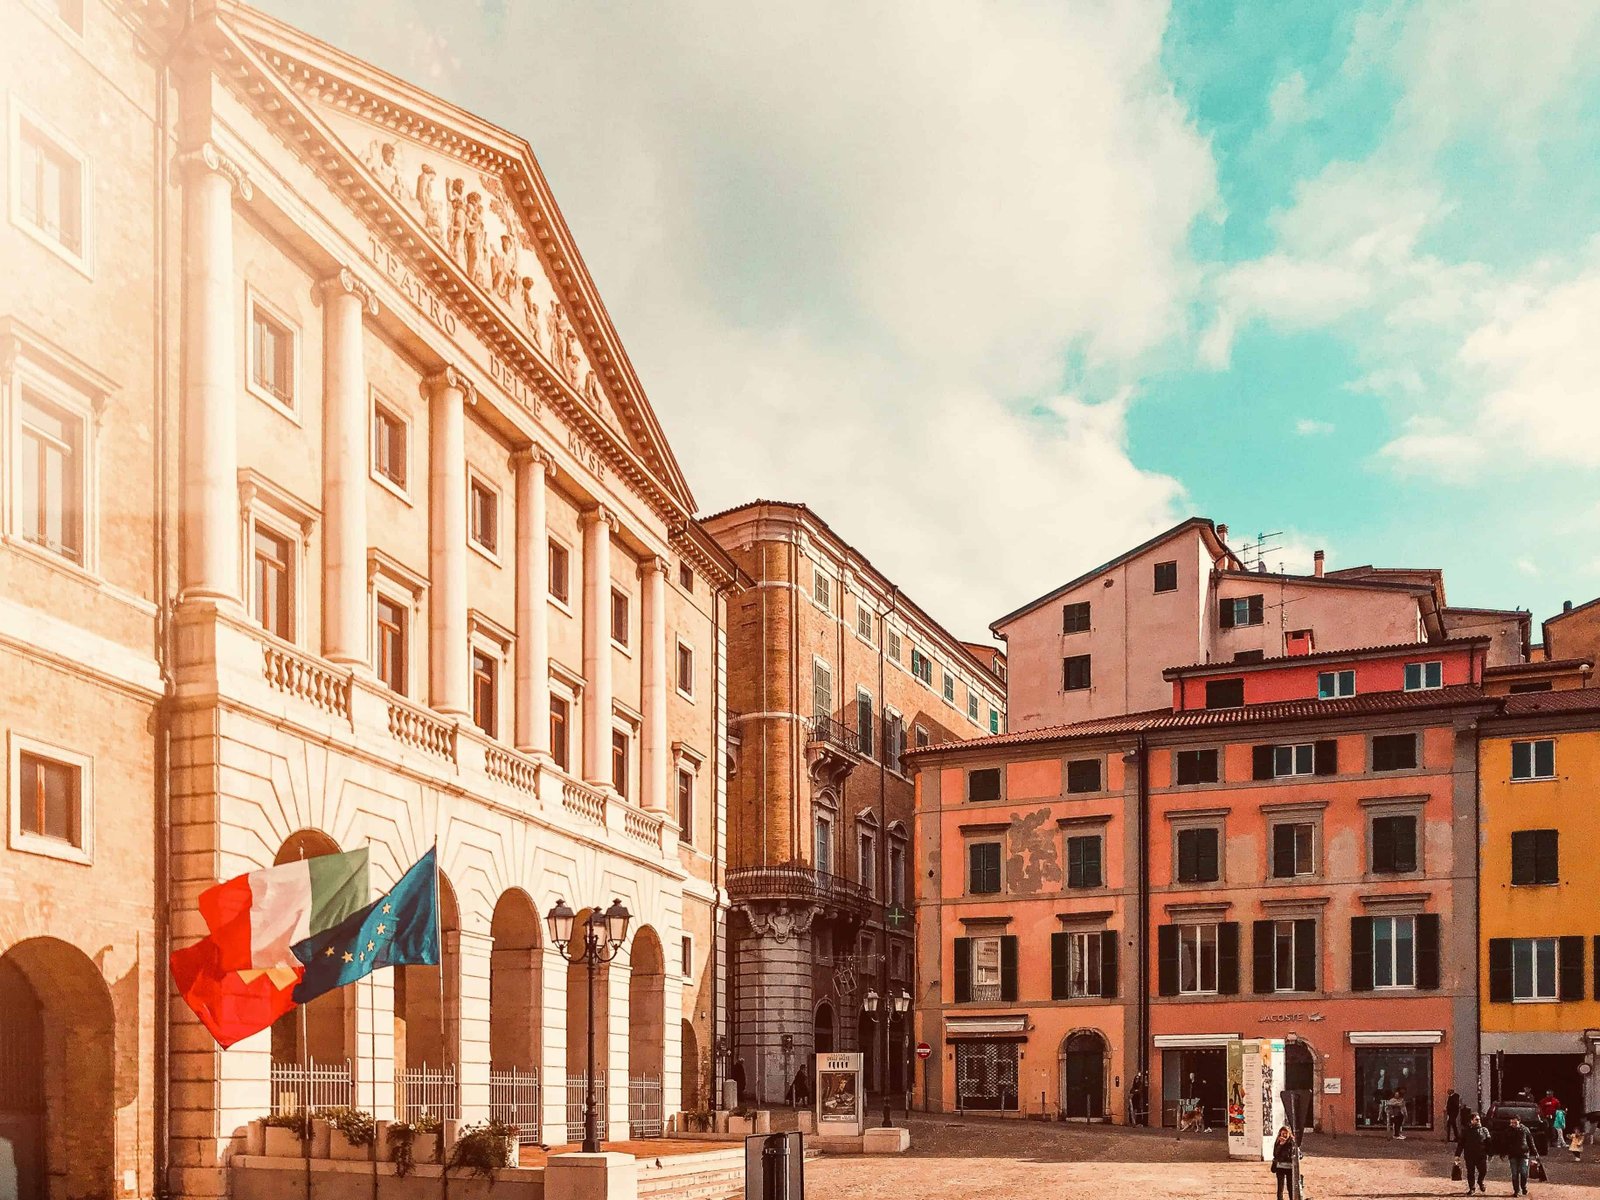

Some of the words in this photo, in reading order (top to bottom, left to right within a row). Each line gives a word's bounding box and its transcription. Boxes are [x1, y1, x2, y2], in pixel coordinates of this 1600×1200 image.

[369, 236, 456, 337] TEATRO
[490, 354, 542, 421] DELLE
[1258, 1013, 1304, 1023] LACOSTE
